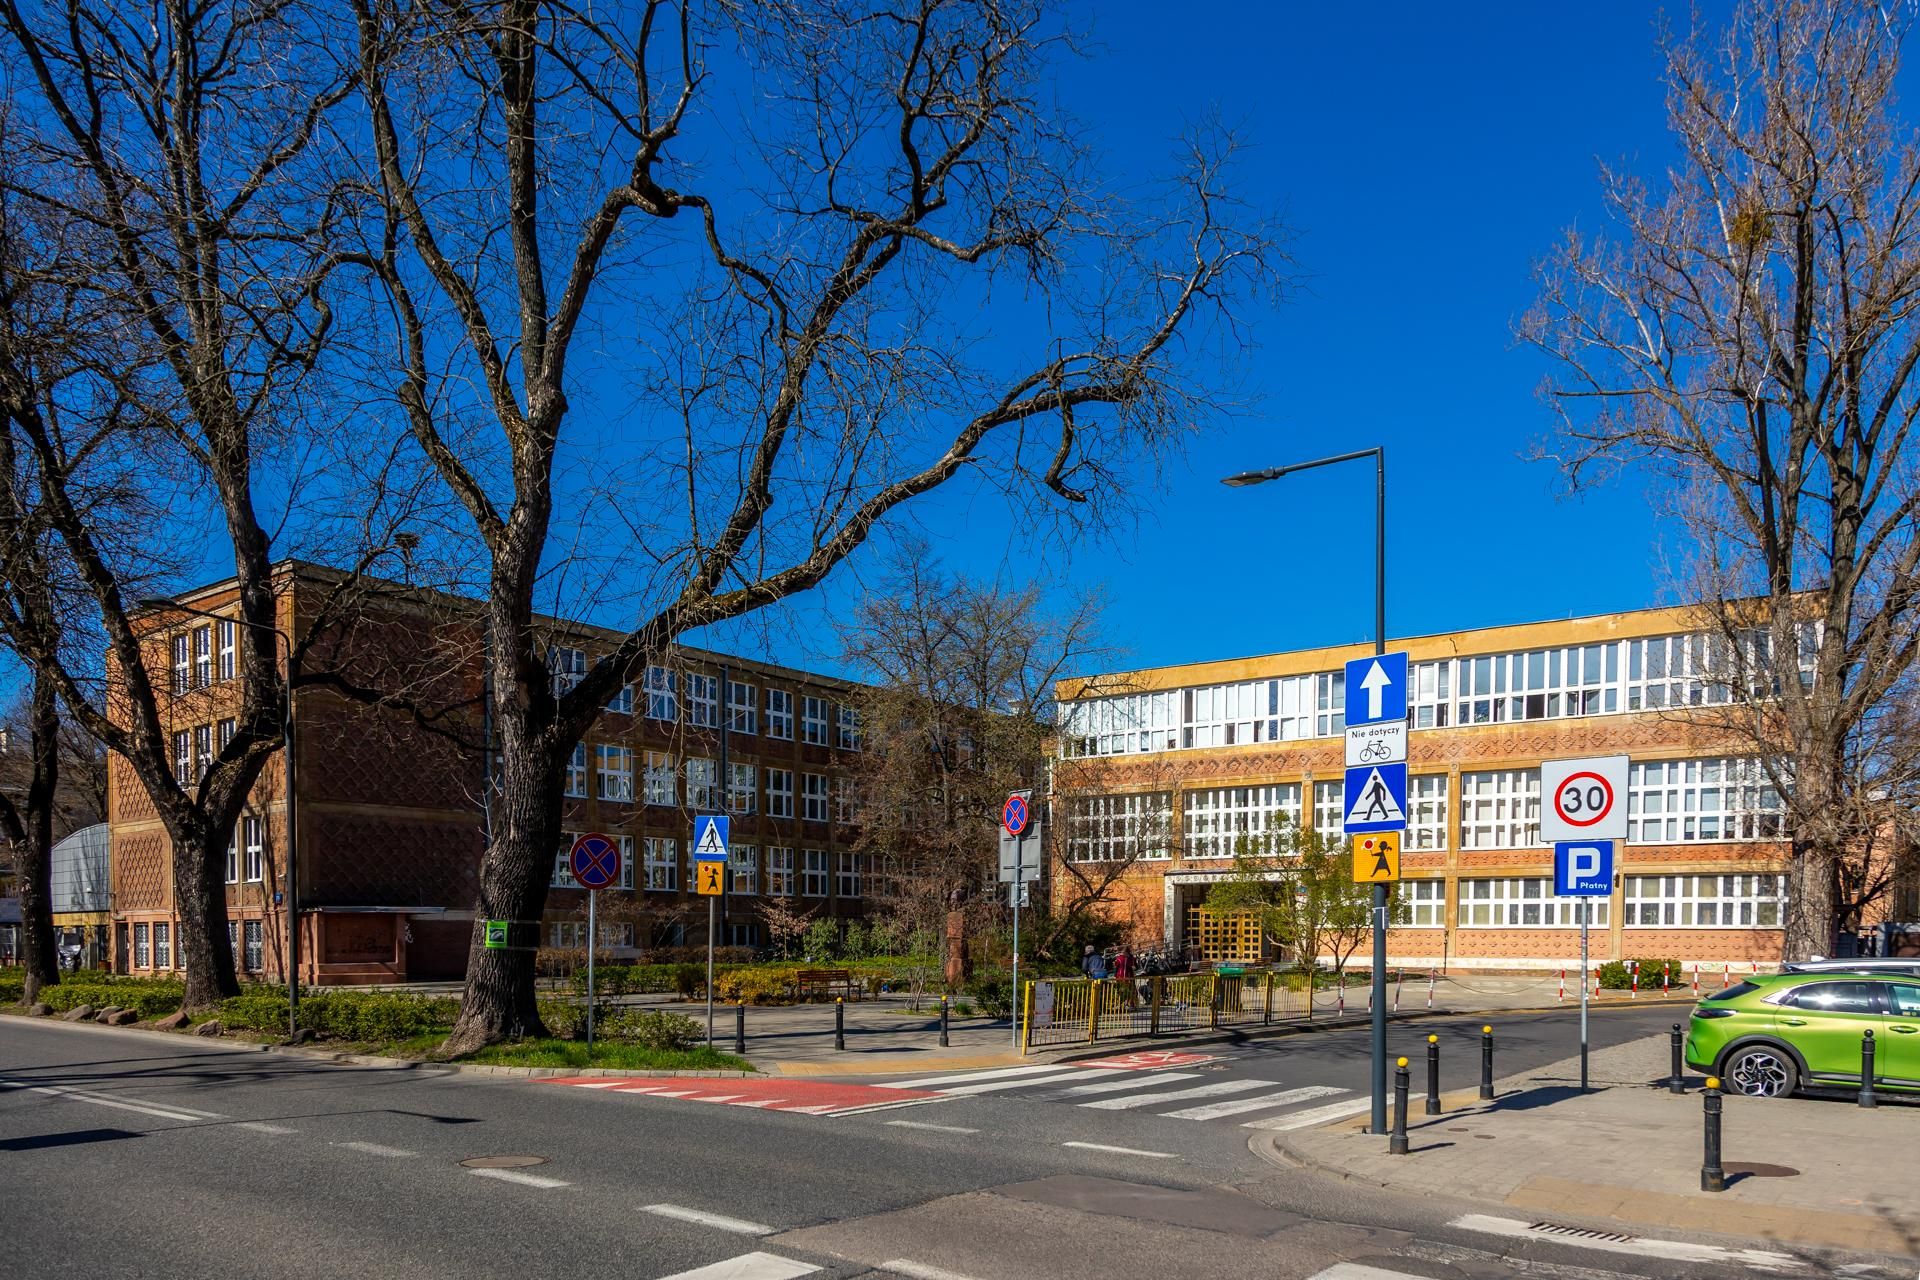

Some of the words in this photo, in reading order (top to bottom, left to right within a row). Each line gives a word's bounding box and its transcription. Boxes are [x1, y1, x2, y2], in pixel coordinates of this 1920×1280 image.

[1351, 730, 1366, 738] Nie
[1369, 727, 1400, 737] dotyczy
[1563, 786, 1604, 813] 30
[1567, 847, 1601, 889] P
[1580, 882, 1608, 891] Płatny
